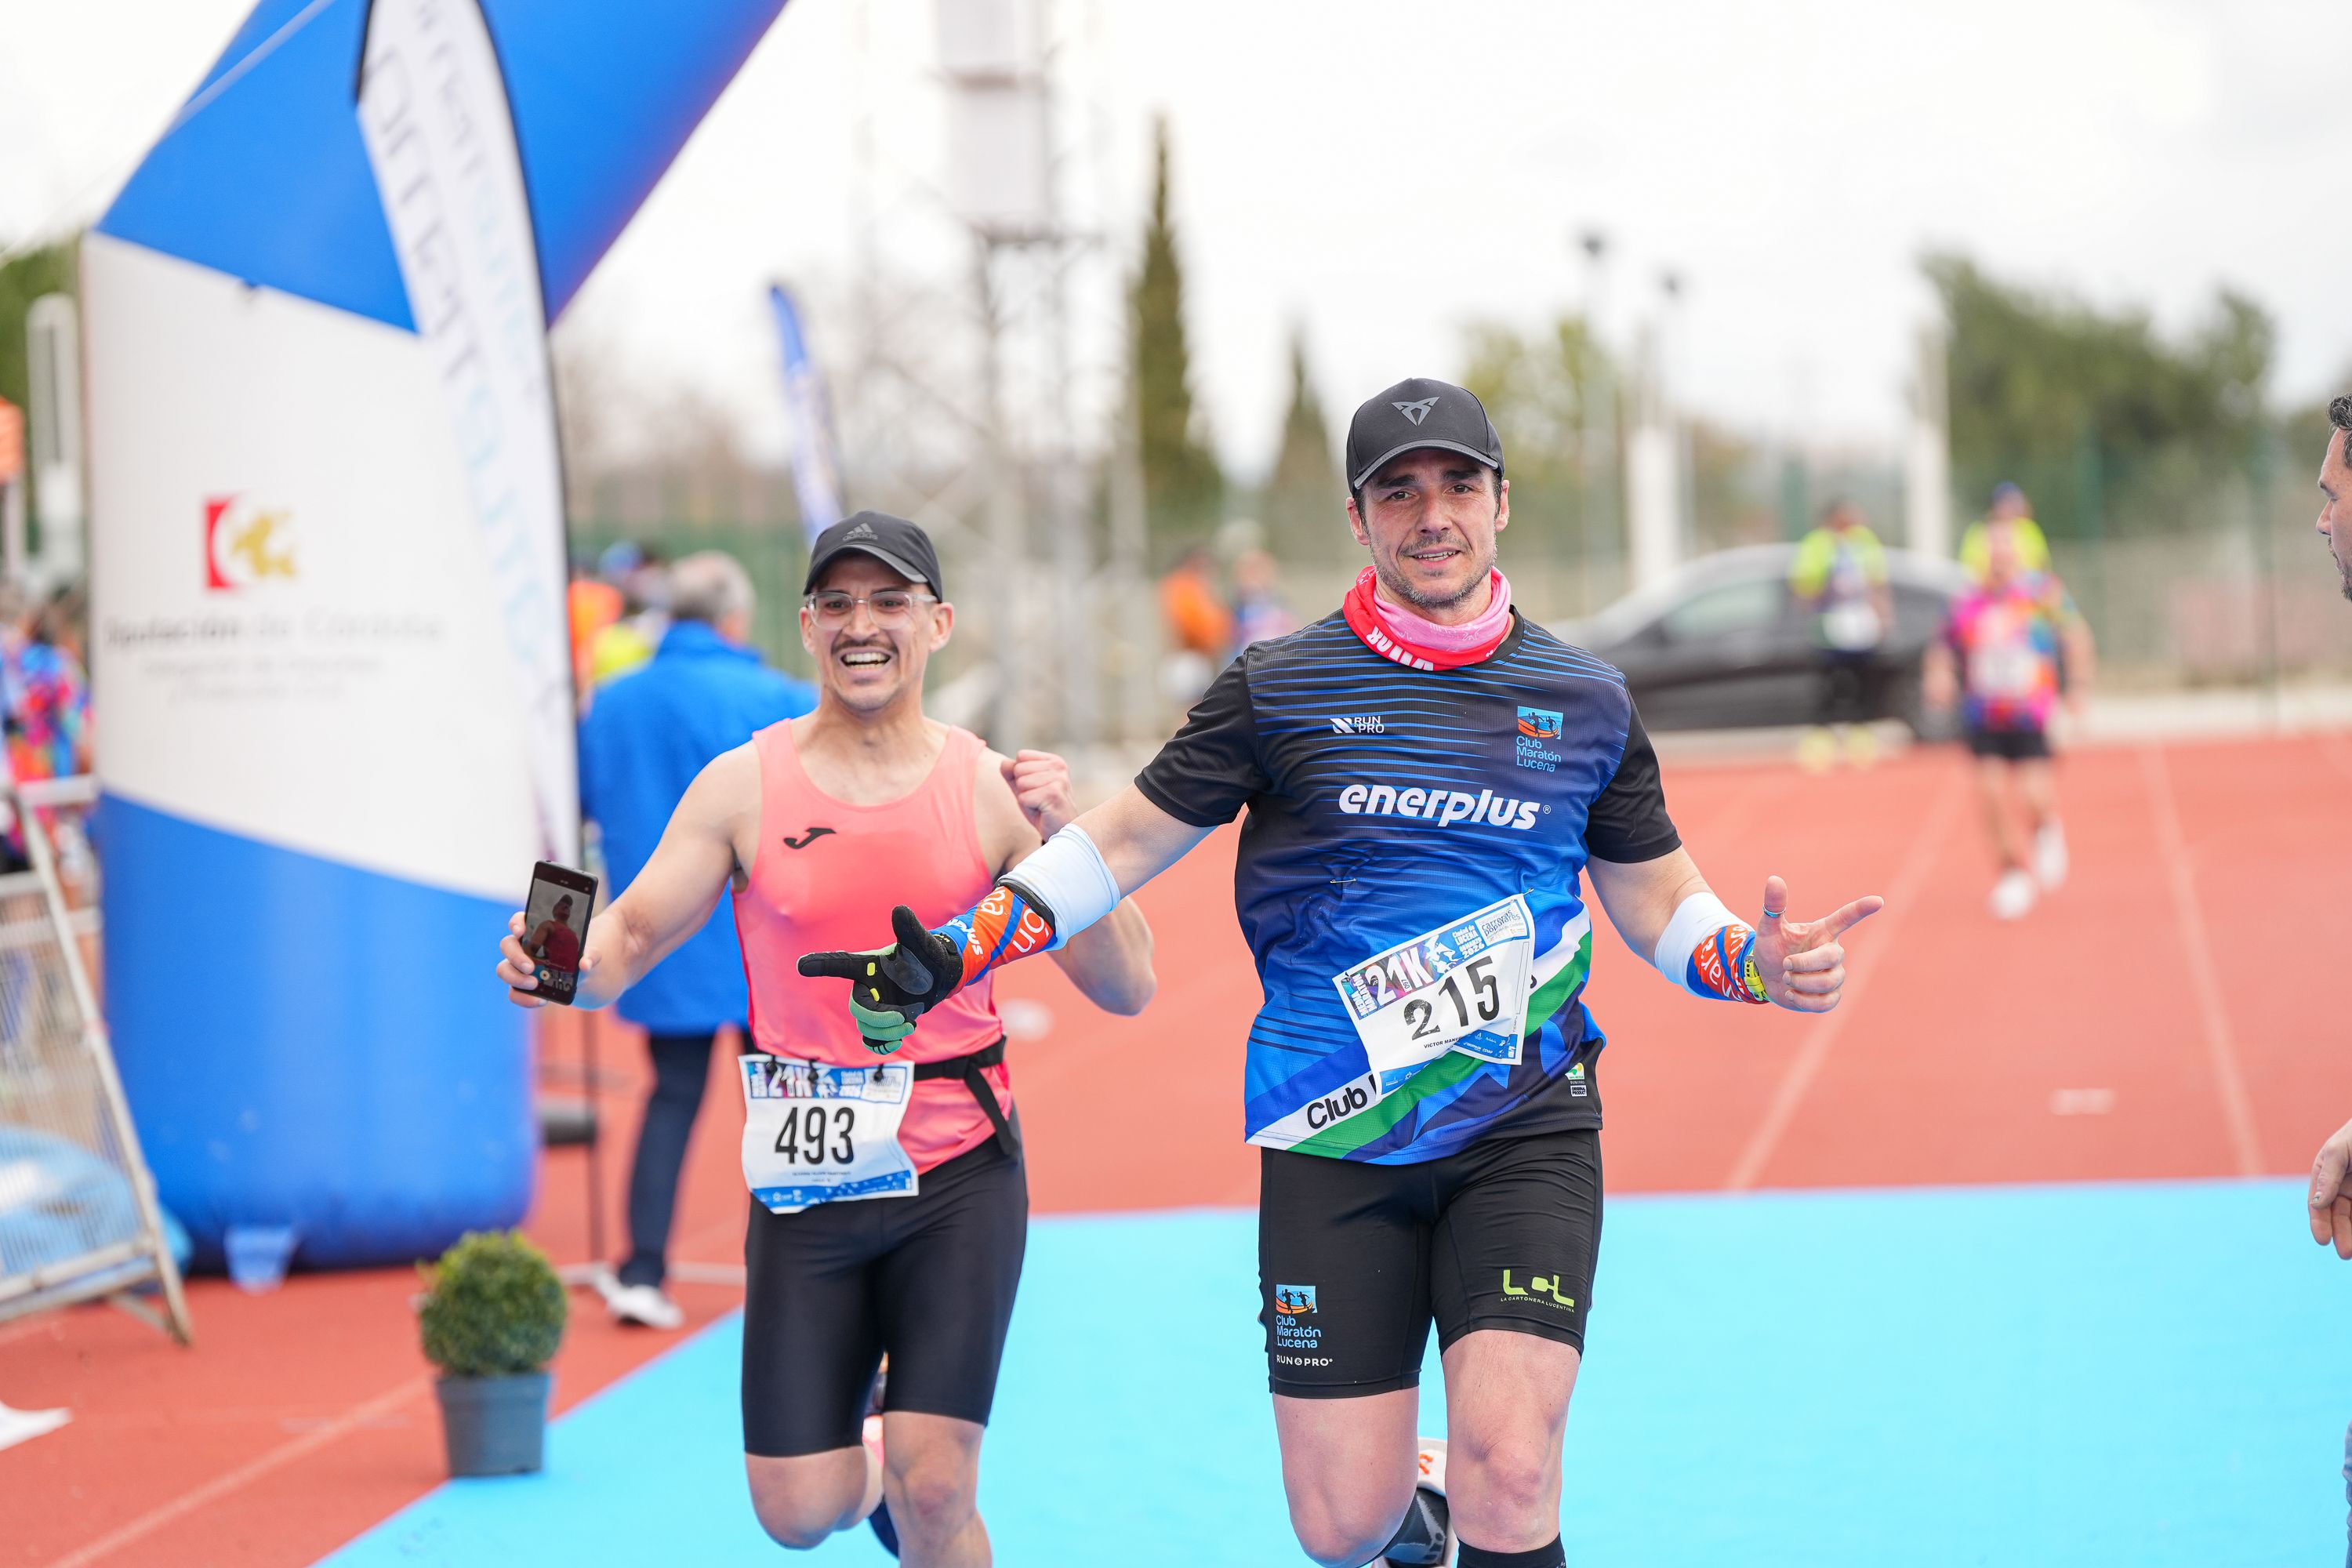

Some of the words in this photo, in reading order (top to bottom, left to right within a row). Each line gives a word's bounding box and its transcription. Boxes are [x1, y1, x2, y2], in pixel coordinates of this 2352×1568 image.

[843, 532, 878, 541] adidas
[1355, 716, 1381, 724] RUN
[1516, 735, 1542, 749] Club
[1516, 746, 1561, 762] Maratón
[1516, 756, 1555, 772] Lucena
[1365, 946, 1434, 1007] 21K
[1403, 955, 1500, 1041] 215
[1424, 1040, 1443, 1049] VICTOR
[1307, 1087, 1368, 1130] Club
[775, 1106, 855, 1165] 493
[1508, 1296, 1545, 1305] CARTONERA
[1545, 1301, 1575, 1313] LUCENTINA
[1276, 1314, 1296, 1327] Club
[1276, 1325, 1322, 1338] Maratón
[1276, 1335, 1318, 1348] Lucena
